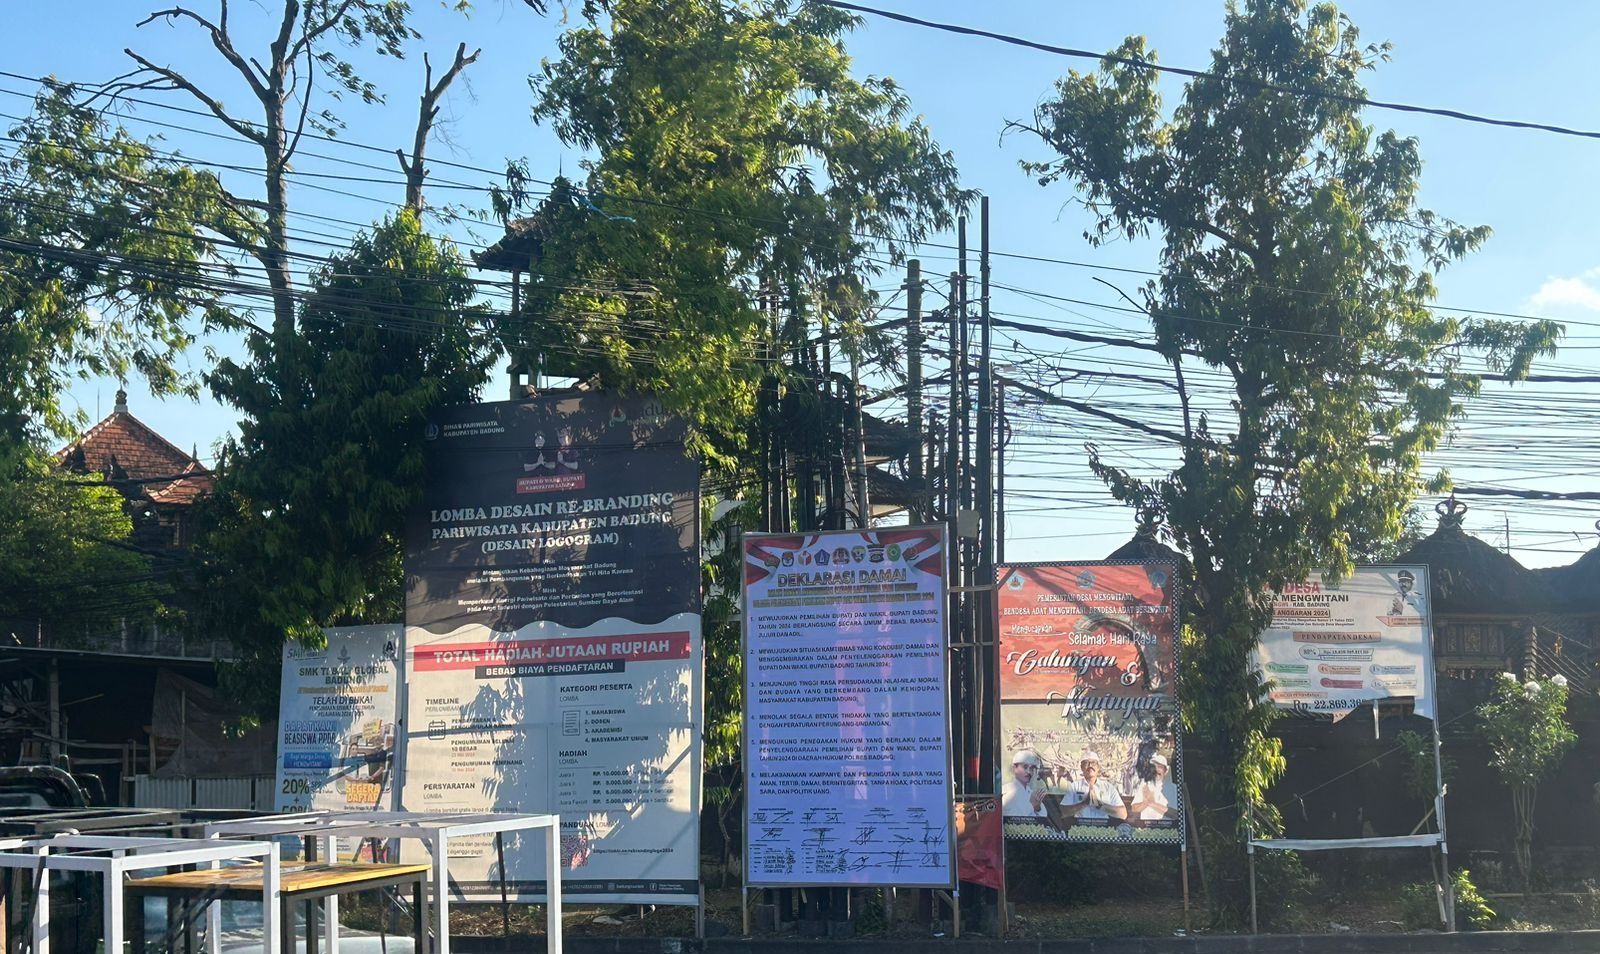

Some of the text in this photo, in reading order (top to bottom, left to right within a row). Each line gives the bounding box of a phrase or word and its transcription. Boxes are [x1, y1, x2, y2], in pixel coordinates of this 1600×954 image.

[462, 421, 498, 430] PARIWISATA
[444, 429, 478, 437] KABUPATEN
[431, 492, 674, 522] LOMBA DESAIN RE-BRANDING
[432, 512, 672, 539] PARIWISATA KABUPATEN BADUNG
[482, 533, 619, 554] (DESAIN LOGOGRAM)
[778, 568, 906, 587] DEKLARASI DAMAI
[1285, 582, 1320, 594] DESA
[1011, 624, 1053, 634] Mengucapkan
[1068, 632, 1157, 646] Selamat Hari Raya
[434, 640, 669, 663] TOTAL HADIAH JUTAAN RUPIAH
[299, 668, 321, 676] SMK
[354, 666, 389, 674] GLOBAL
[486, 668, 516, 676] BEBAS
[548, 663, 613, 673] PENDAFTARAN
[1006, 649, 1142, 686] Galungan &
[326, 676, 362, 685] BADUNG
[284, 733, 316, 744] BEASISWA
[282, 779, 310, 794] 20%
